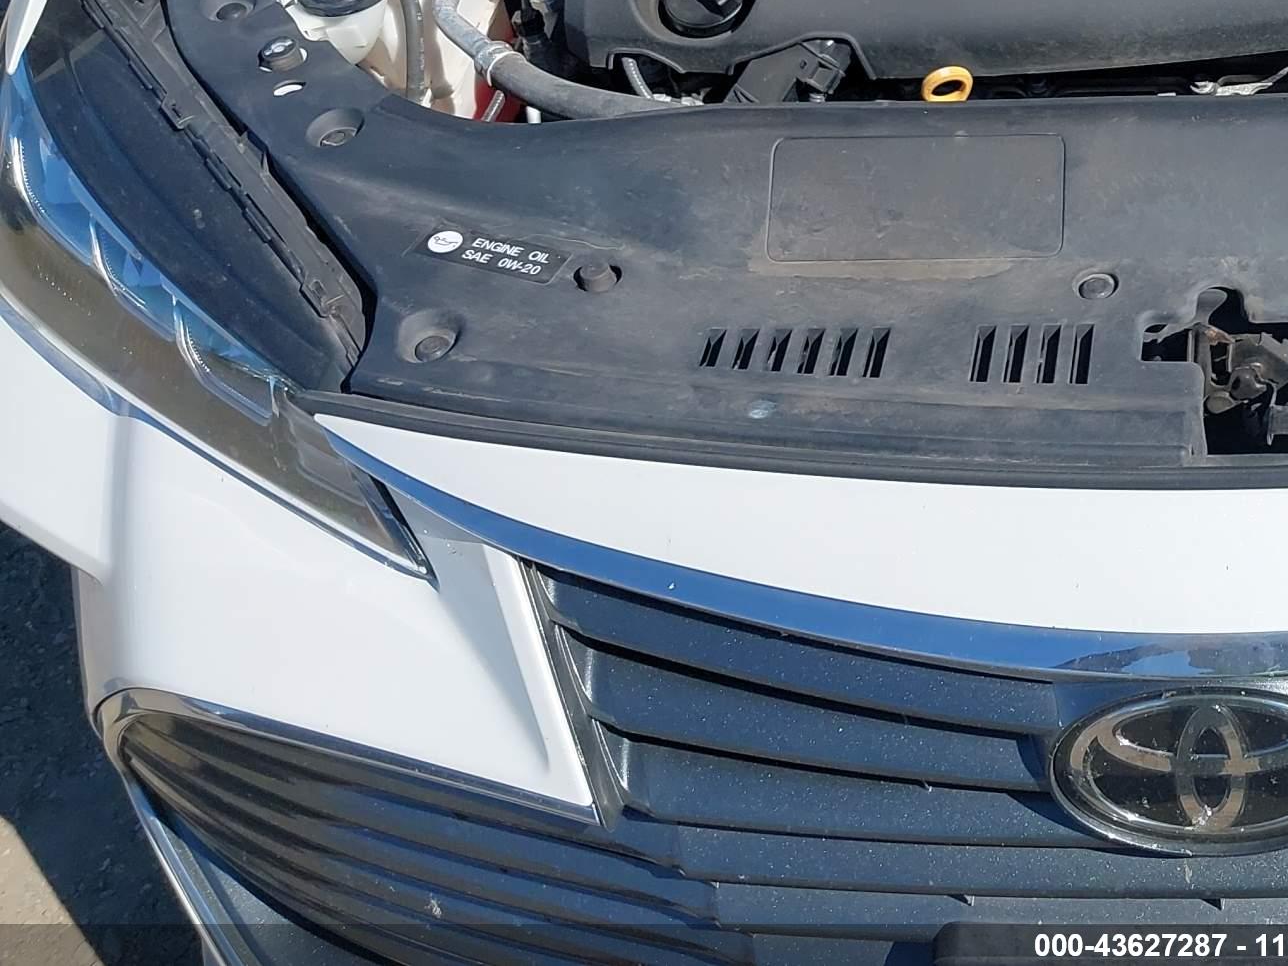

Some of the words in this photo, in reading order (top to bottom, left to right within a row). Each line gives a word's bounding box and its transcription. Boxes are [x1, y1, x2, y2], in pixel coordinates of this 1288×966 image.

[461, 249, 493, 264] SAE
[497, 257, 542, 275] 0W-20
[471, 237, 525, 257] ENGINE
[528, 251, 551, 264] OIL
